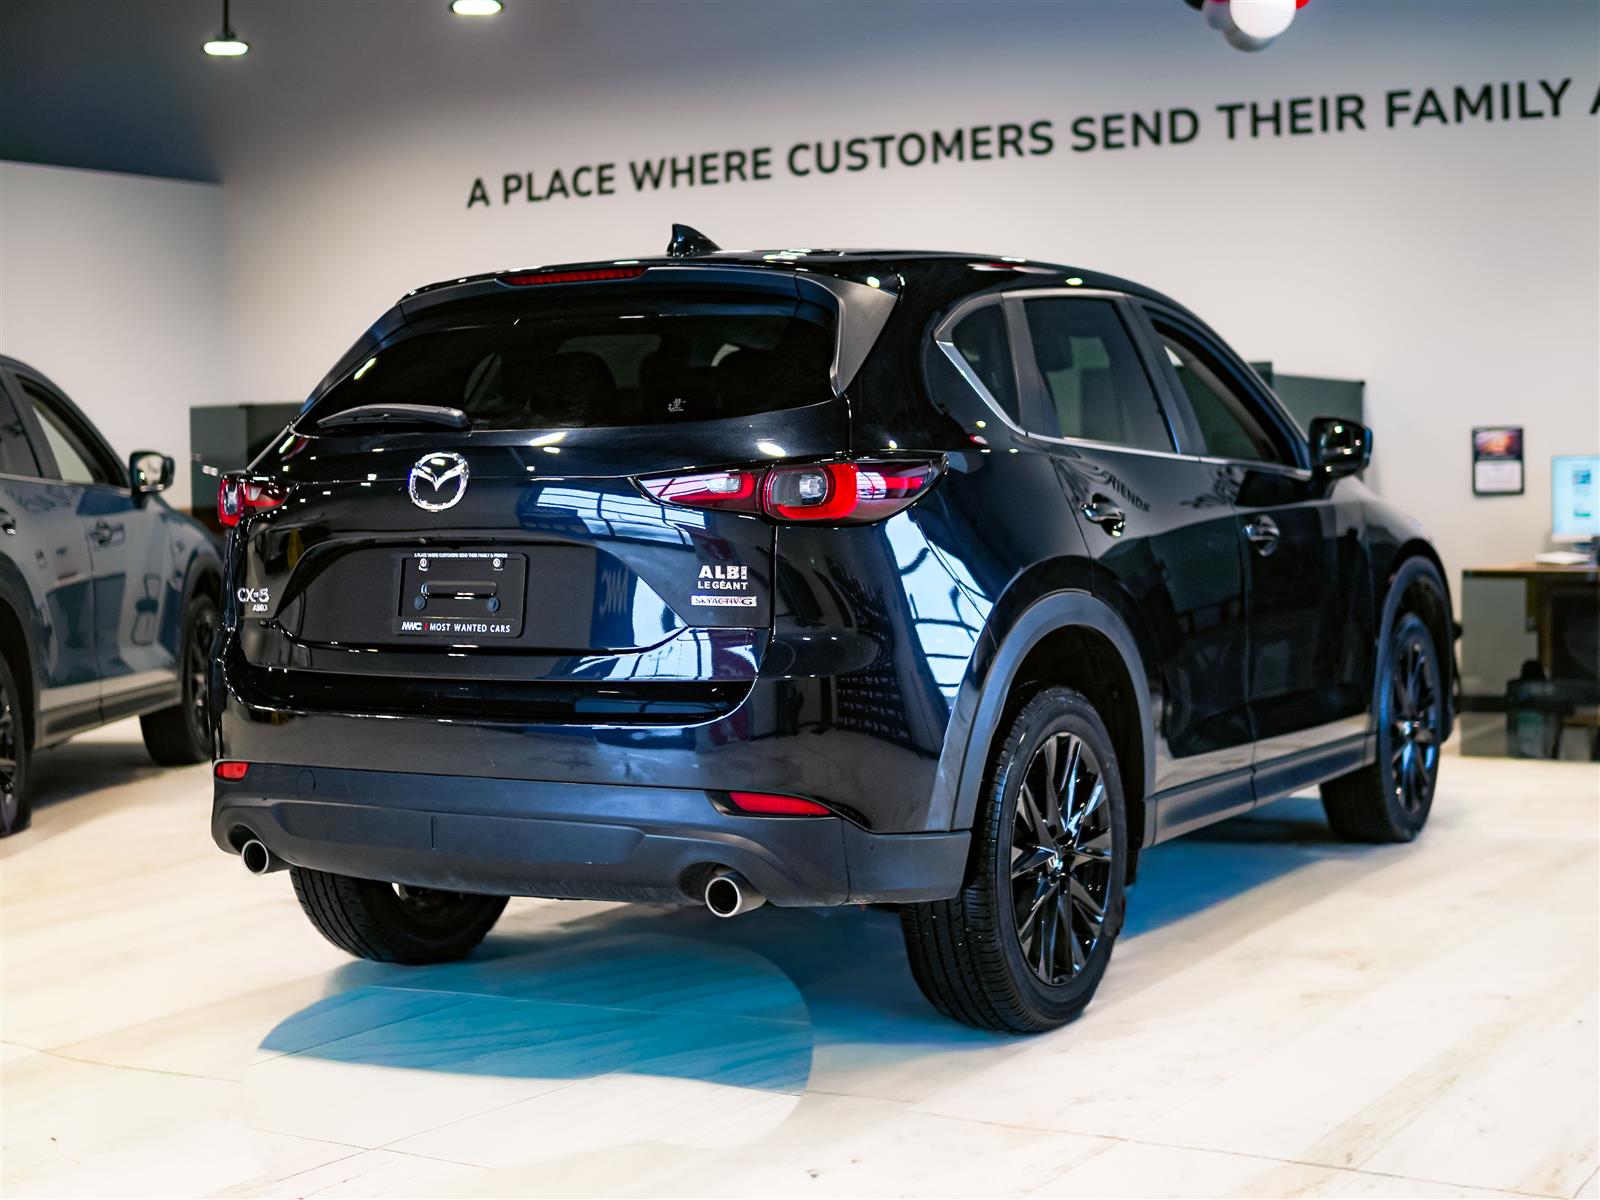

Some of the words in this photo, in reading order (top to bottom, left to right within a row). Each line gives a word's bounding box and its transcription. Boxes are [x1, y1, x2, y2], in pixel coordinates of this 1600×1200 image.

[467, 178, 491, 209] A
[502, 162, 616, 205] PLACE
[628, 146, 773, 192] WHERE
[786, 120, 1055, 178] CUSTOMERS
[1070, 108, 1201, 153] SEND
[1215, 93, 1367, 141] THEIR
[1384, 77, 1573, 129] FAMILY
[698, 564, 748, 580] ALBI
[697, 580, 711, 590] LE
[711, 580, 748, 591] GÉANT
[237, 587, 270, 603] CX-5
[429, 622, 451, 632] MOST
[453, 623, 487, 633] WANTED
[489, 624, 511, 633] CARS
